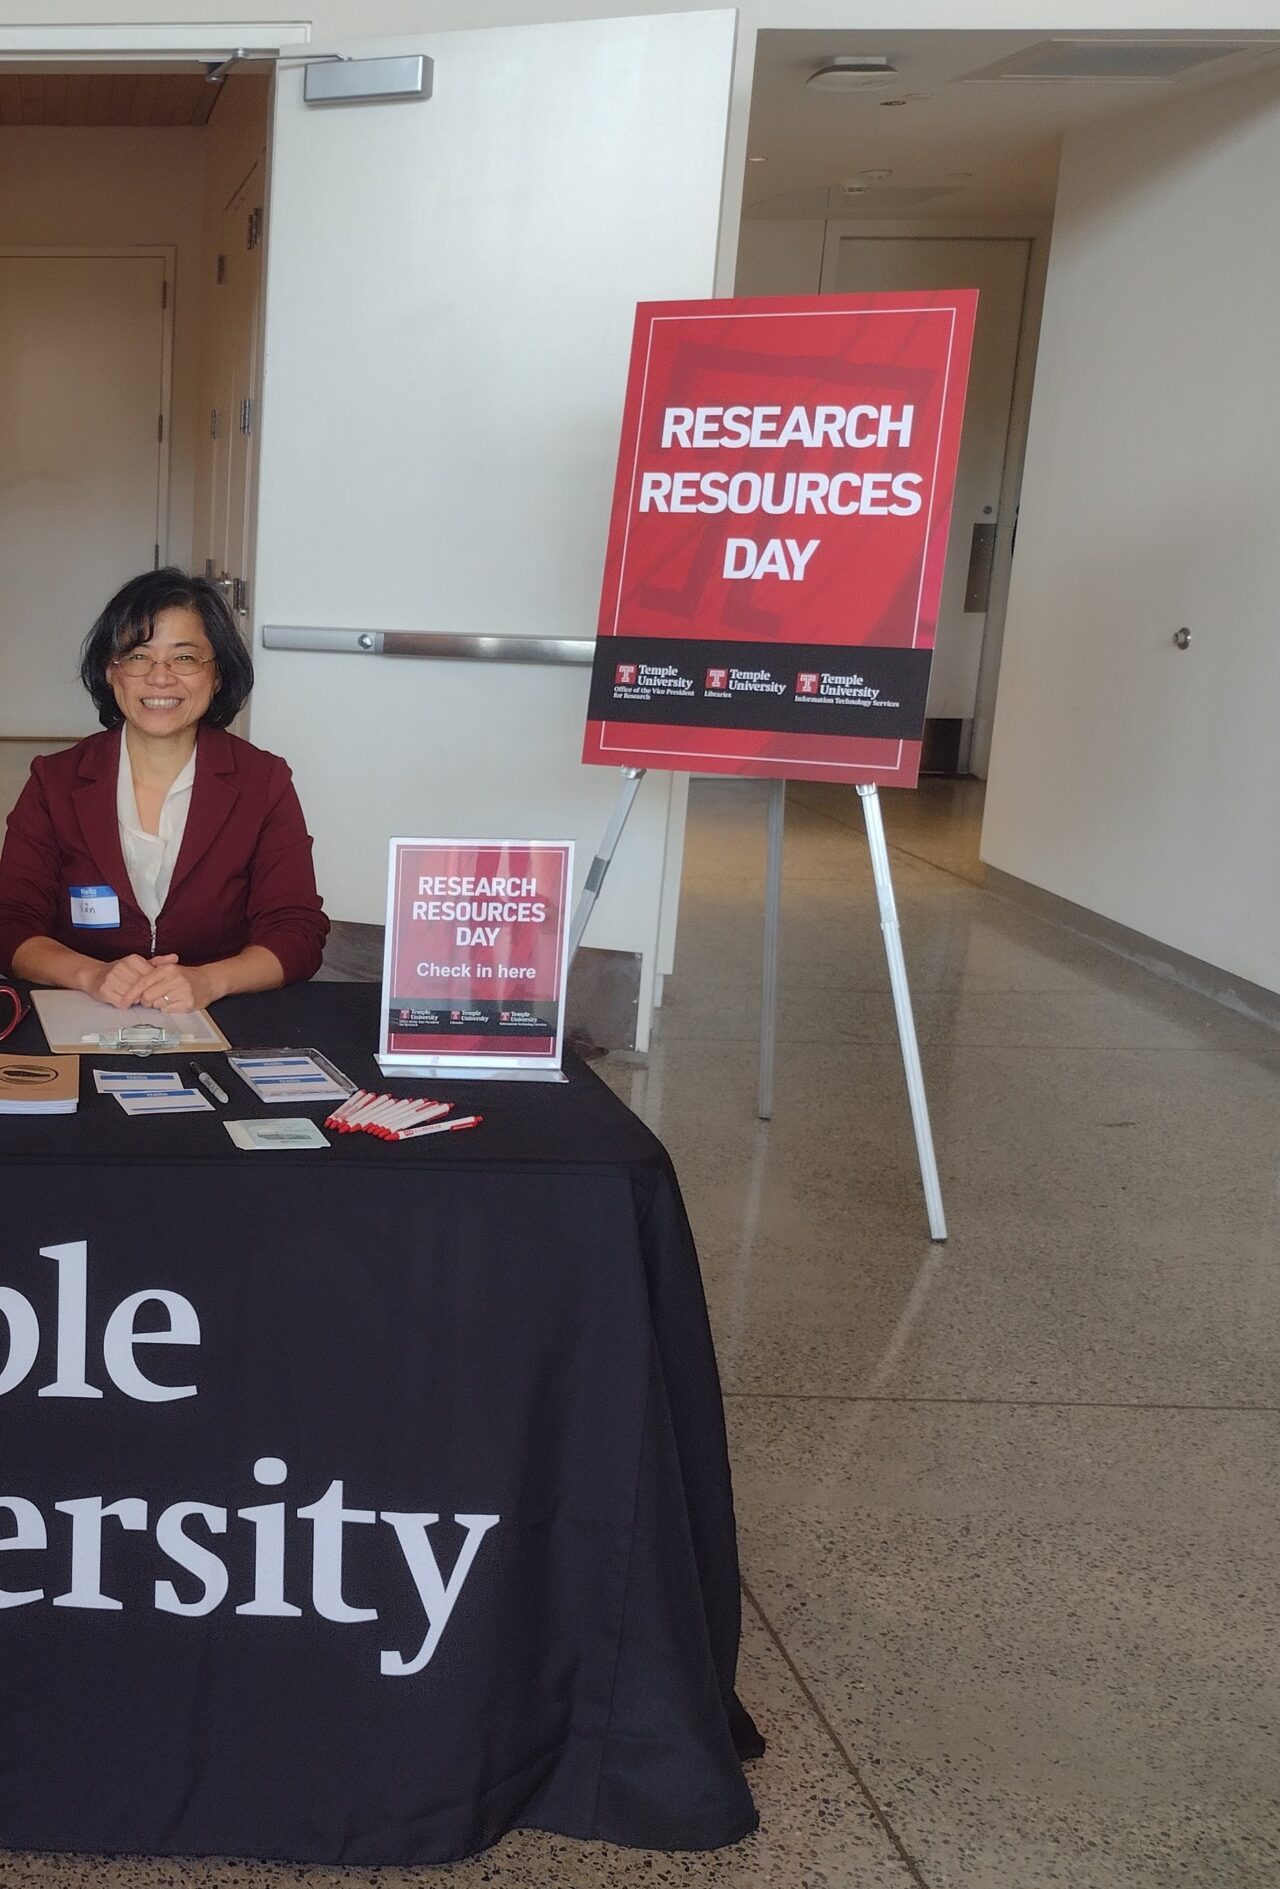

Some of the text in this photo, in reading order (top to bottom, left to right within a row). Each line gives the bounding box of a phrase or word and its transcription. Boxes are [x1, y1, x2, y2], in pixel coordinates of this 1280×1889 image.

[661, 404, 915, 449] RESEARCH
[638, 472, 923, 516] RESOURCES
[722, 538, 821, 581] DAY
[638, 664, 679, 678] Temple
[729, 669, 771, 683] Temple
[637, 675, 694, 690] University
[728, 679, 787, 695] University
[821, 673, 864, 687] Temple
[704, 690, 732, 698] Libraries
[820, 684, 880, 700] University
[794, 695, 900, 708] Information Technology Services
[418, 876, 536, 897] RESEARCH
[412, 901, 546, 922] RESOURCES
[456, 927, 500, 947] DAY
[416, 962, 536, 979] Check in here
